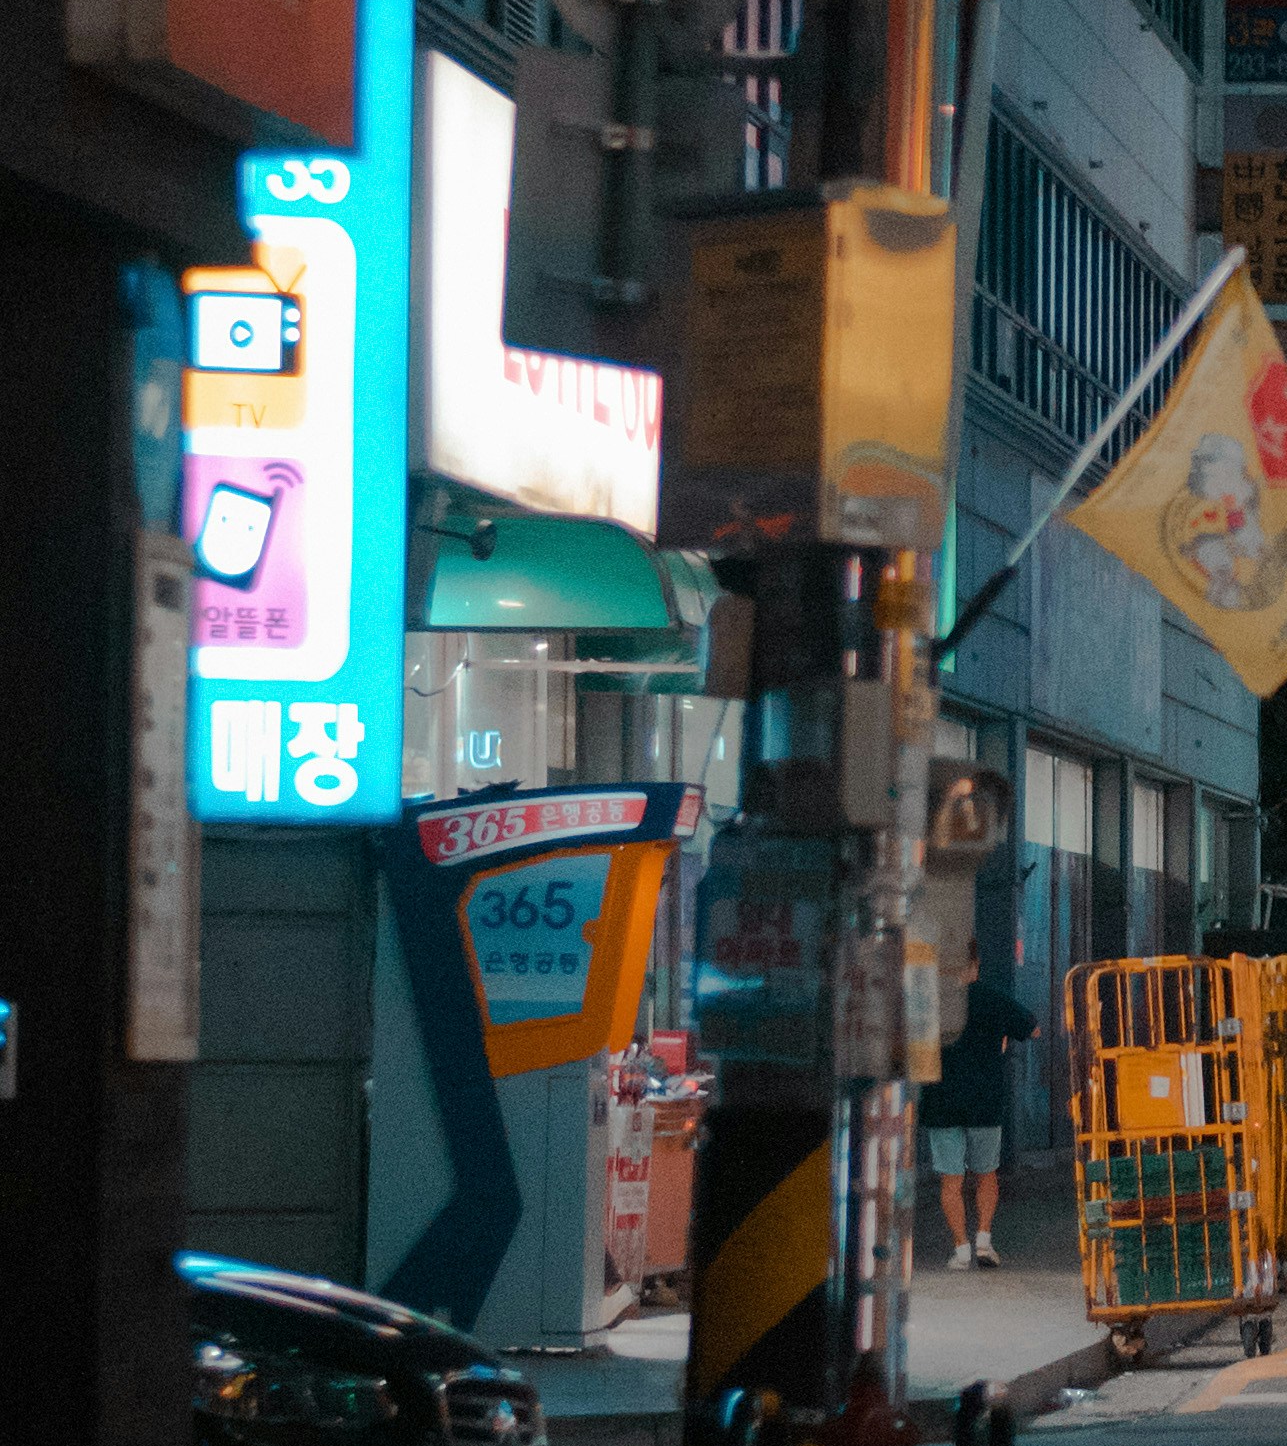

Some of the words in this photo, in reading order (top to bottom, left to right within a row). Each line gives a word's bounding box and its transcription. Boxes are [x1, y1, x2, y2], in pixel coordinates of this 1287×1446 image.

[231, 402, 267, 429] TV
[204, 606, 292, 642] 알뜰폰
[210, 699, 365, 807] 매장
[437, 806, 527, 857] 365
[479, 880, 576, 930] 365
[483, 950, 581, 975] 은행공동
